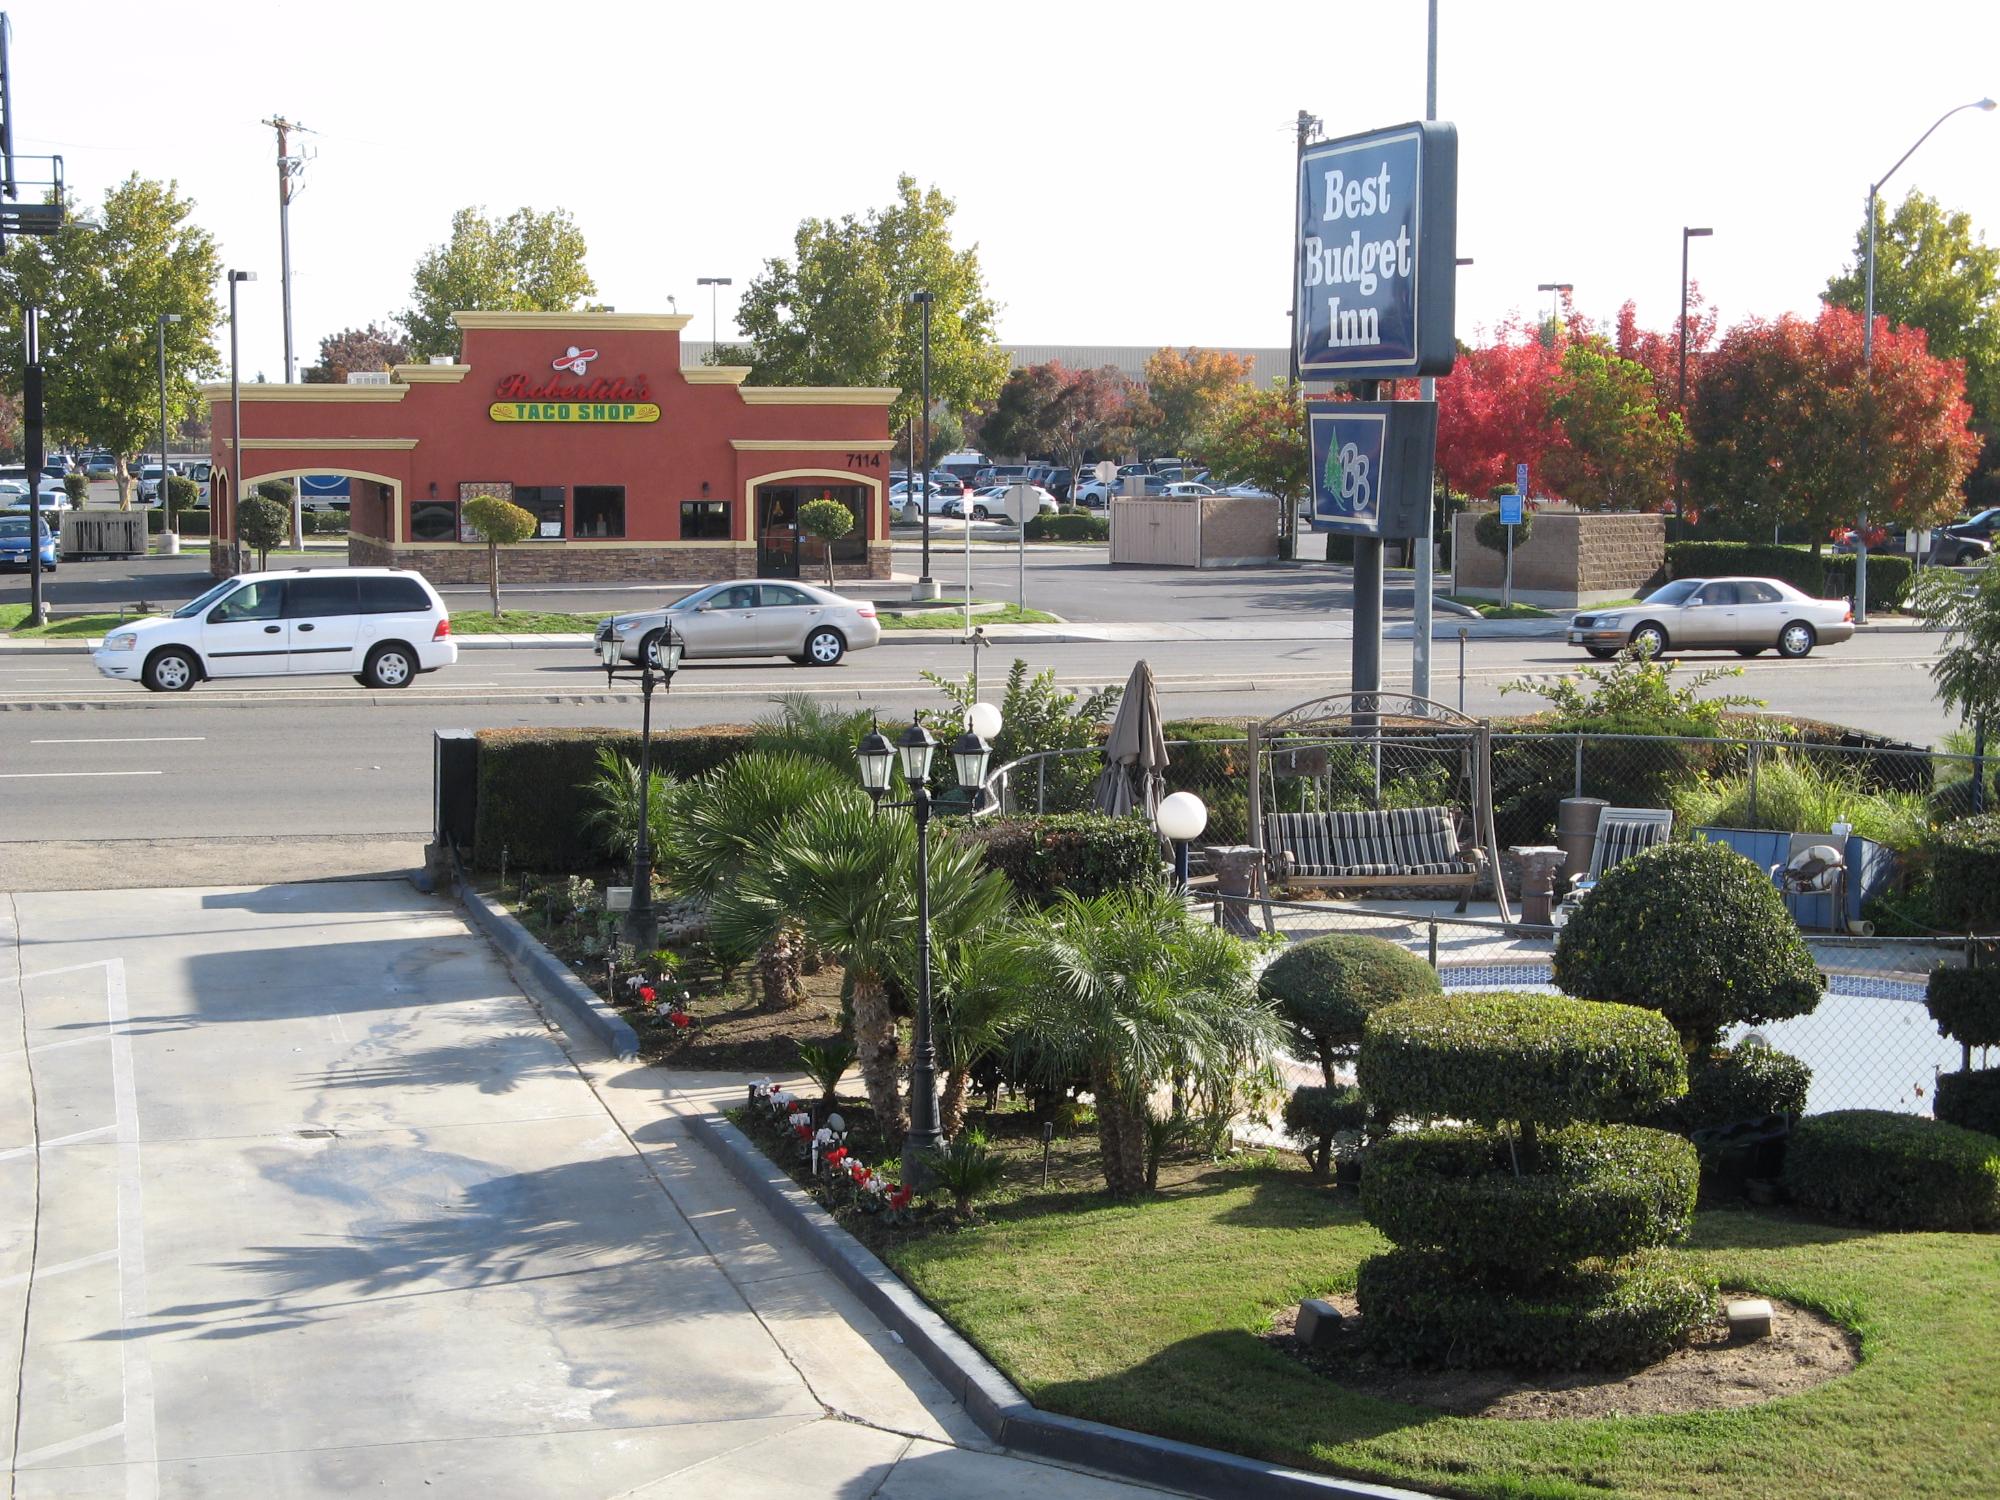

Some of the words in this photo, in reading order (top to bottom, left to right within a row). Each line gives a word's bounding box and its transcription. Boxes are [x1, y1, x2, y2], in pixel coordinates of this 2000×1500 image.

[1323, 161, 1391, 222] Best
[1304, 224, 1411, 296] Budget
[1328, 297, 1381, 348] Inn
[516, 404, 570, 420] TACO
[578, 404, 635, 420] SHOP
[846, 453, 880, 468] 7114
